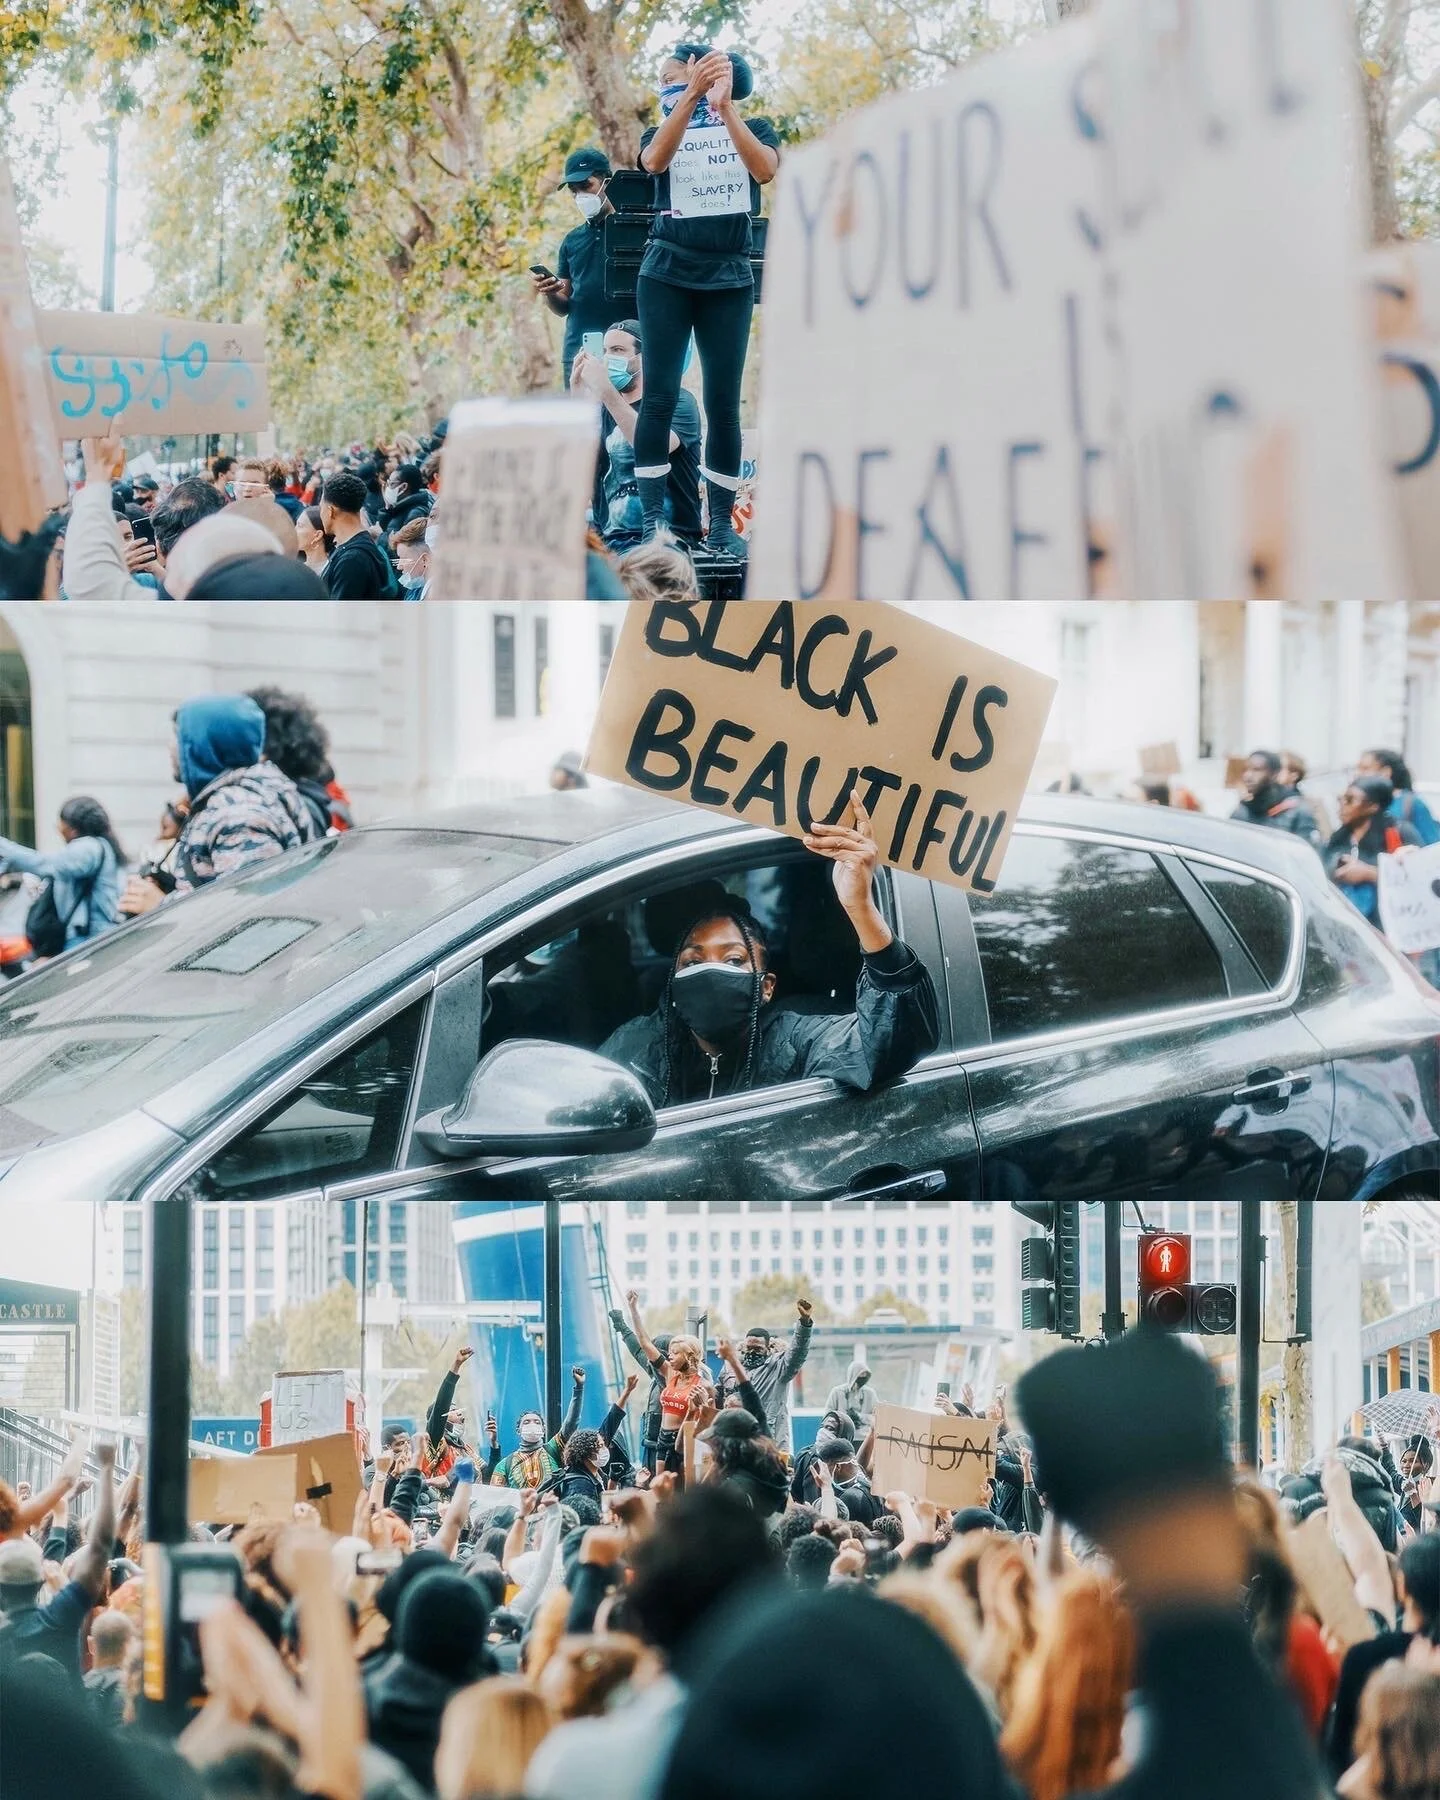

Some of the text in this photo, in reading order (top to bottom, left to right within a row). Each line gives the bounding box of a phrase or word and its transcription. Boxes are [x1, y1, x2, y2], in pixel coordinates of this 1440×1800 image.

[678, 138, 731, 152] QUALIT
[708, 152, 739, 165] NOT
[692, 182, 744, 197] SLAVERY
[793, 101, 1013, 328] YOUR
[645, 601, 1008, 773] BLACK IS
[625, 688, 1007, 892] BEAUTIFUL
[0, 1303, 66, 1319] CASTLE
[275, 1382, 320, 1408] LET
[279, 1410, 311, 1430] US
[204, 1430, 236, 1445] AFT
[888, 1426, 992, 1471] RACISM
